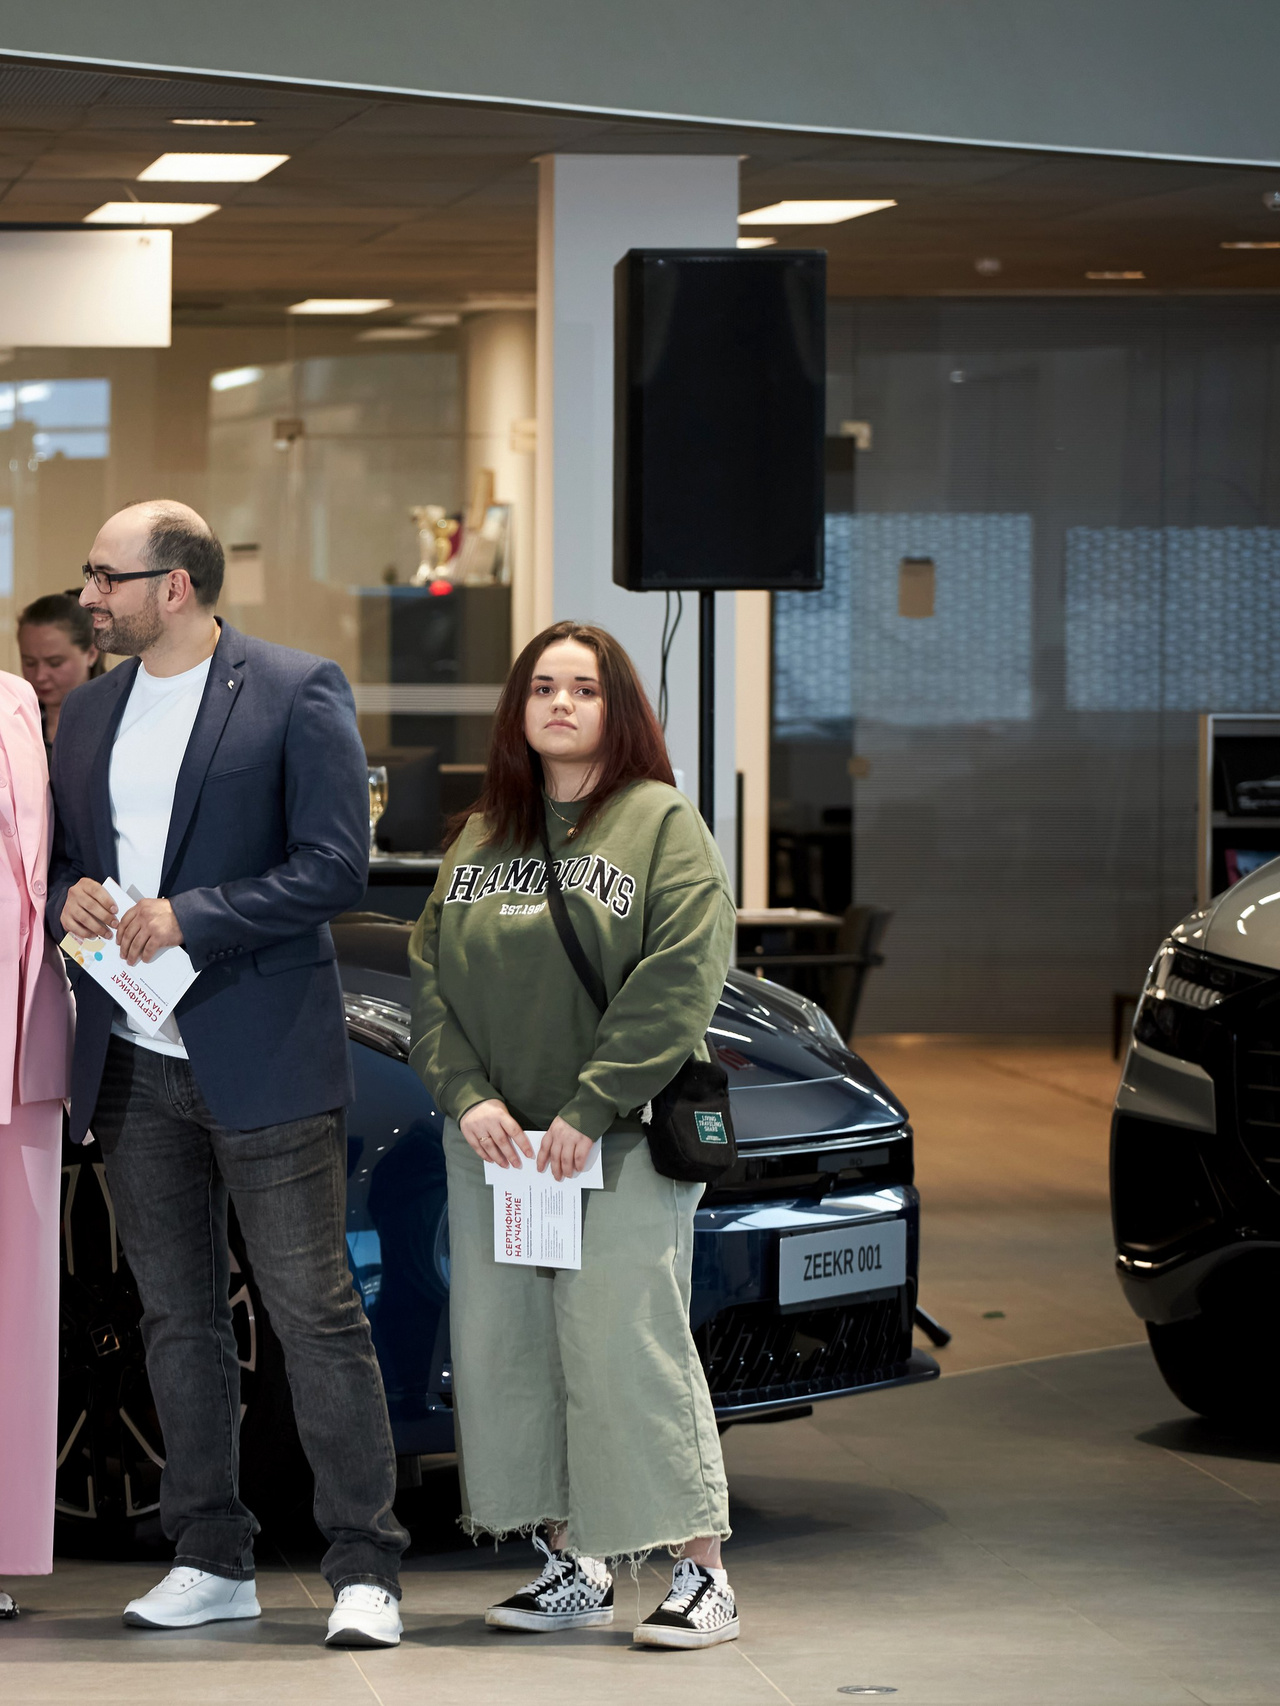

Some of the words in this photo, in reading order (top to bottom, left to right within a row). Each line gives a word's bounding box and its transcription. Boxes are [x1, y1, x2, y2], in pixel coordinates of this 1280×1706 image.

[111, 974, 158, 1022] СЕРТИФИКАТ
[120, 970, 153, 1005] УЧАСТИЕ
[152, 1002, 164, 1016] НА
[505, 1190, 513, 1257] СЕРТИФИКАТ
[514, 1197, 522, 1242] УЧАСТИЕ
[514, 1243, 522, 1258] НА
[803, 1248, 854, 1282] ZEEKR
[858, 1243, 882, 1273] 001
